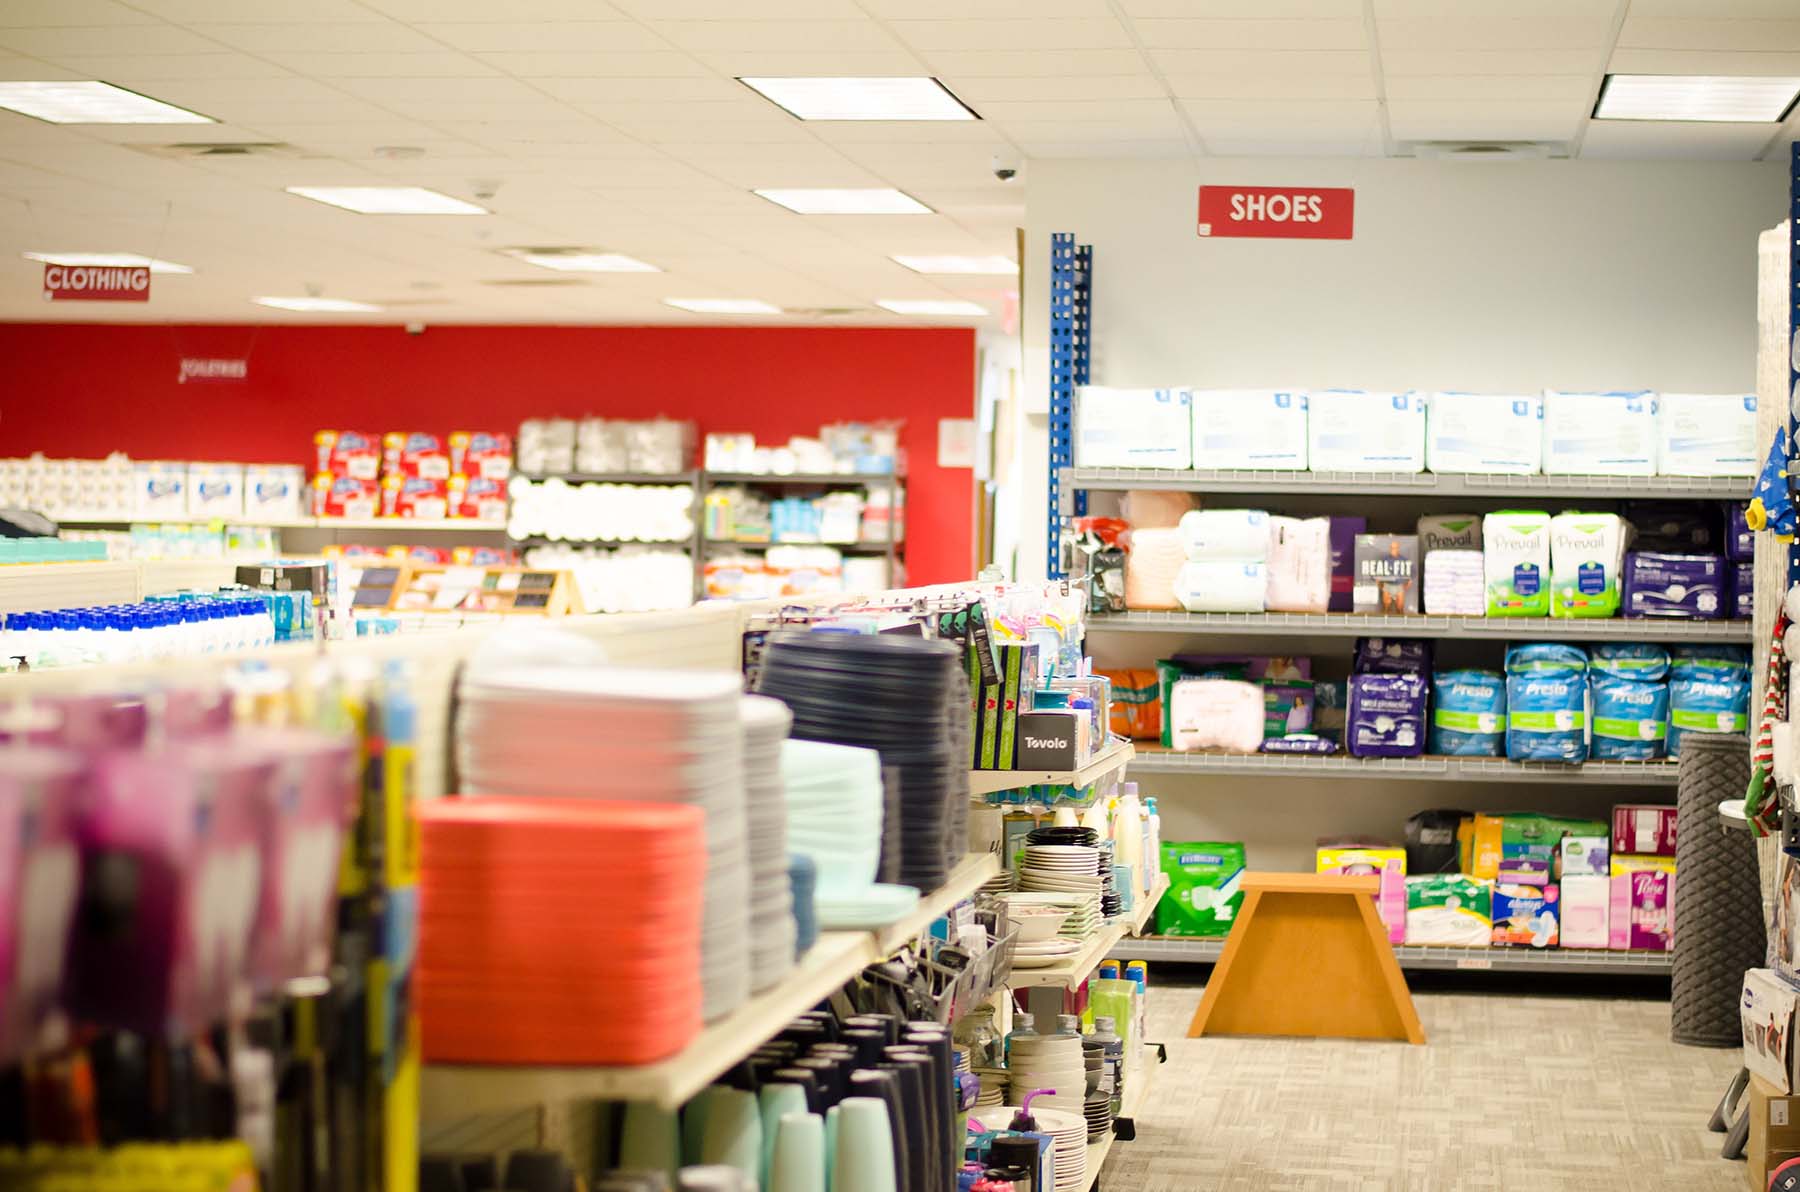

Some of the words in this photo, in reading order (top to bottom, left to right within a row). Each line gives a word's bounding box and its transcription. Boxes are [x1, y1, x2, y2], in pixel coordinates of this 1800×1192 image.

[1229, 193, 1323, 223] SHOES
[46, 267, 149, 291] CLOTHING
[1425, 531, 1472, 548] Prevail
[1495, 535, 1541, 549] Prevail
[1557, 535, 1605, 549] Prevail
[1452, 684, 1494, 698] Presto
[1525, 682, 1569, 697] Presto
[1611, 689, 1654, 705] Presto
[1024, 737, 1068, 749] Tovolo
[1634, 873, 1665, 895] Poise
